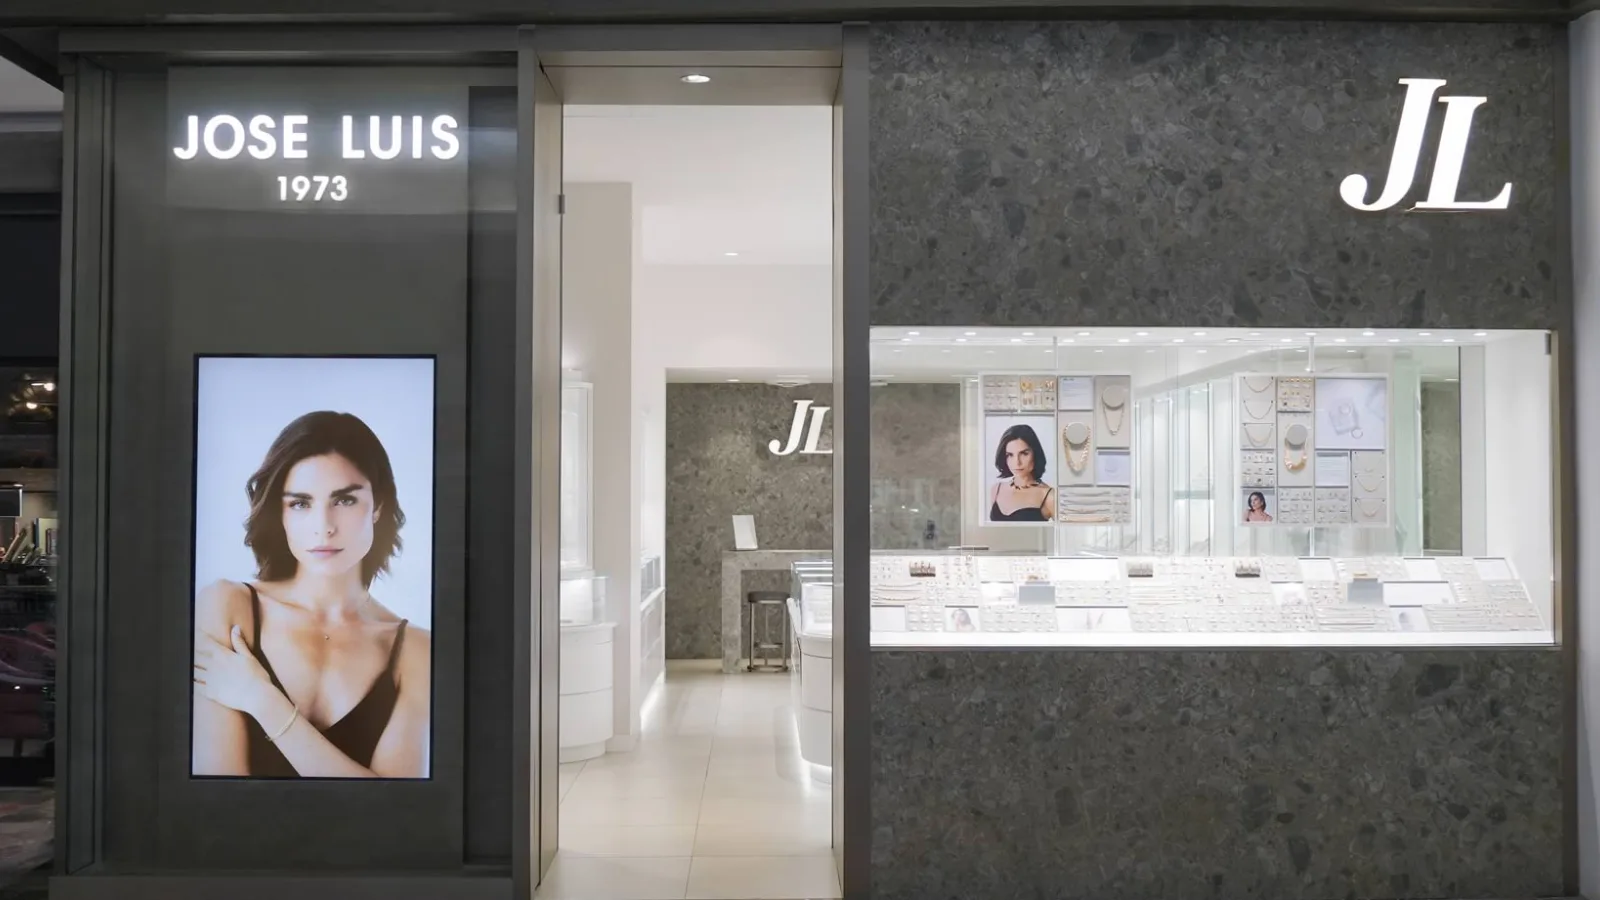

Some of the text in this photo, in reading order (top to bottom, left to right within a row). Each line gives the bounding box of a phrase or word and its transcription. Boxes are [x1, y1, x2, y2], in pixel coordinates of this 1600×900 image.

[173, 114, 460, 160] JOSE LUIS
[1339, 78, 1512, 211] JL
[277, 175, 348, 202] 1973
[768, 400, 833, 456] JL
